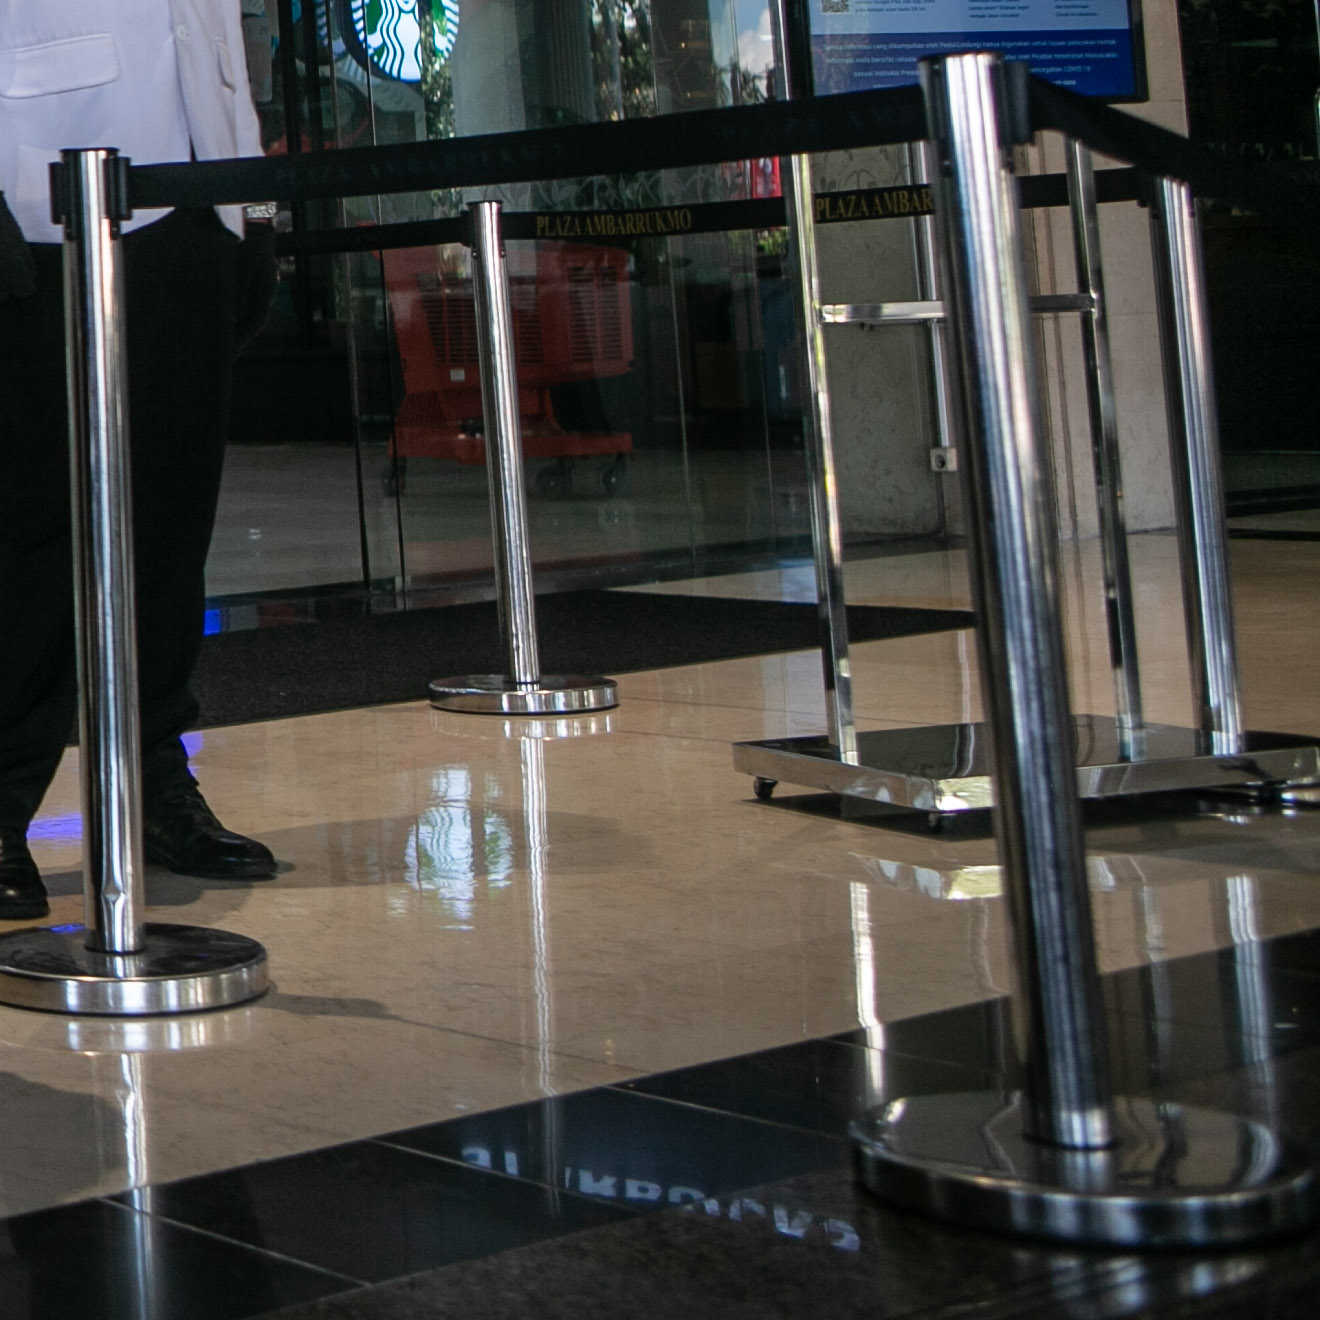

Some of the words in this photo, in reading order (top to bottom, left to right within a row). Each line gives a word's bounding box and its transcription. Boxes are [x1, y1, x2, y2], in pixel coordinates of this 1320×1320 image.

[815, 195, 870, 220] PLAZA
[536, 215, 582, 237] PLAZA
[583, 208, 692, 236] AMBARRUKMO
